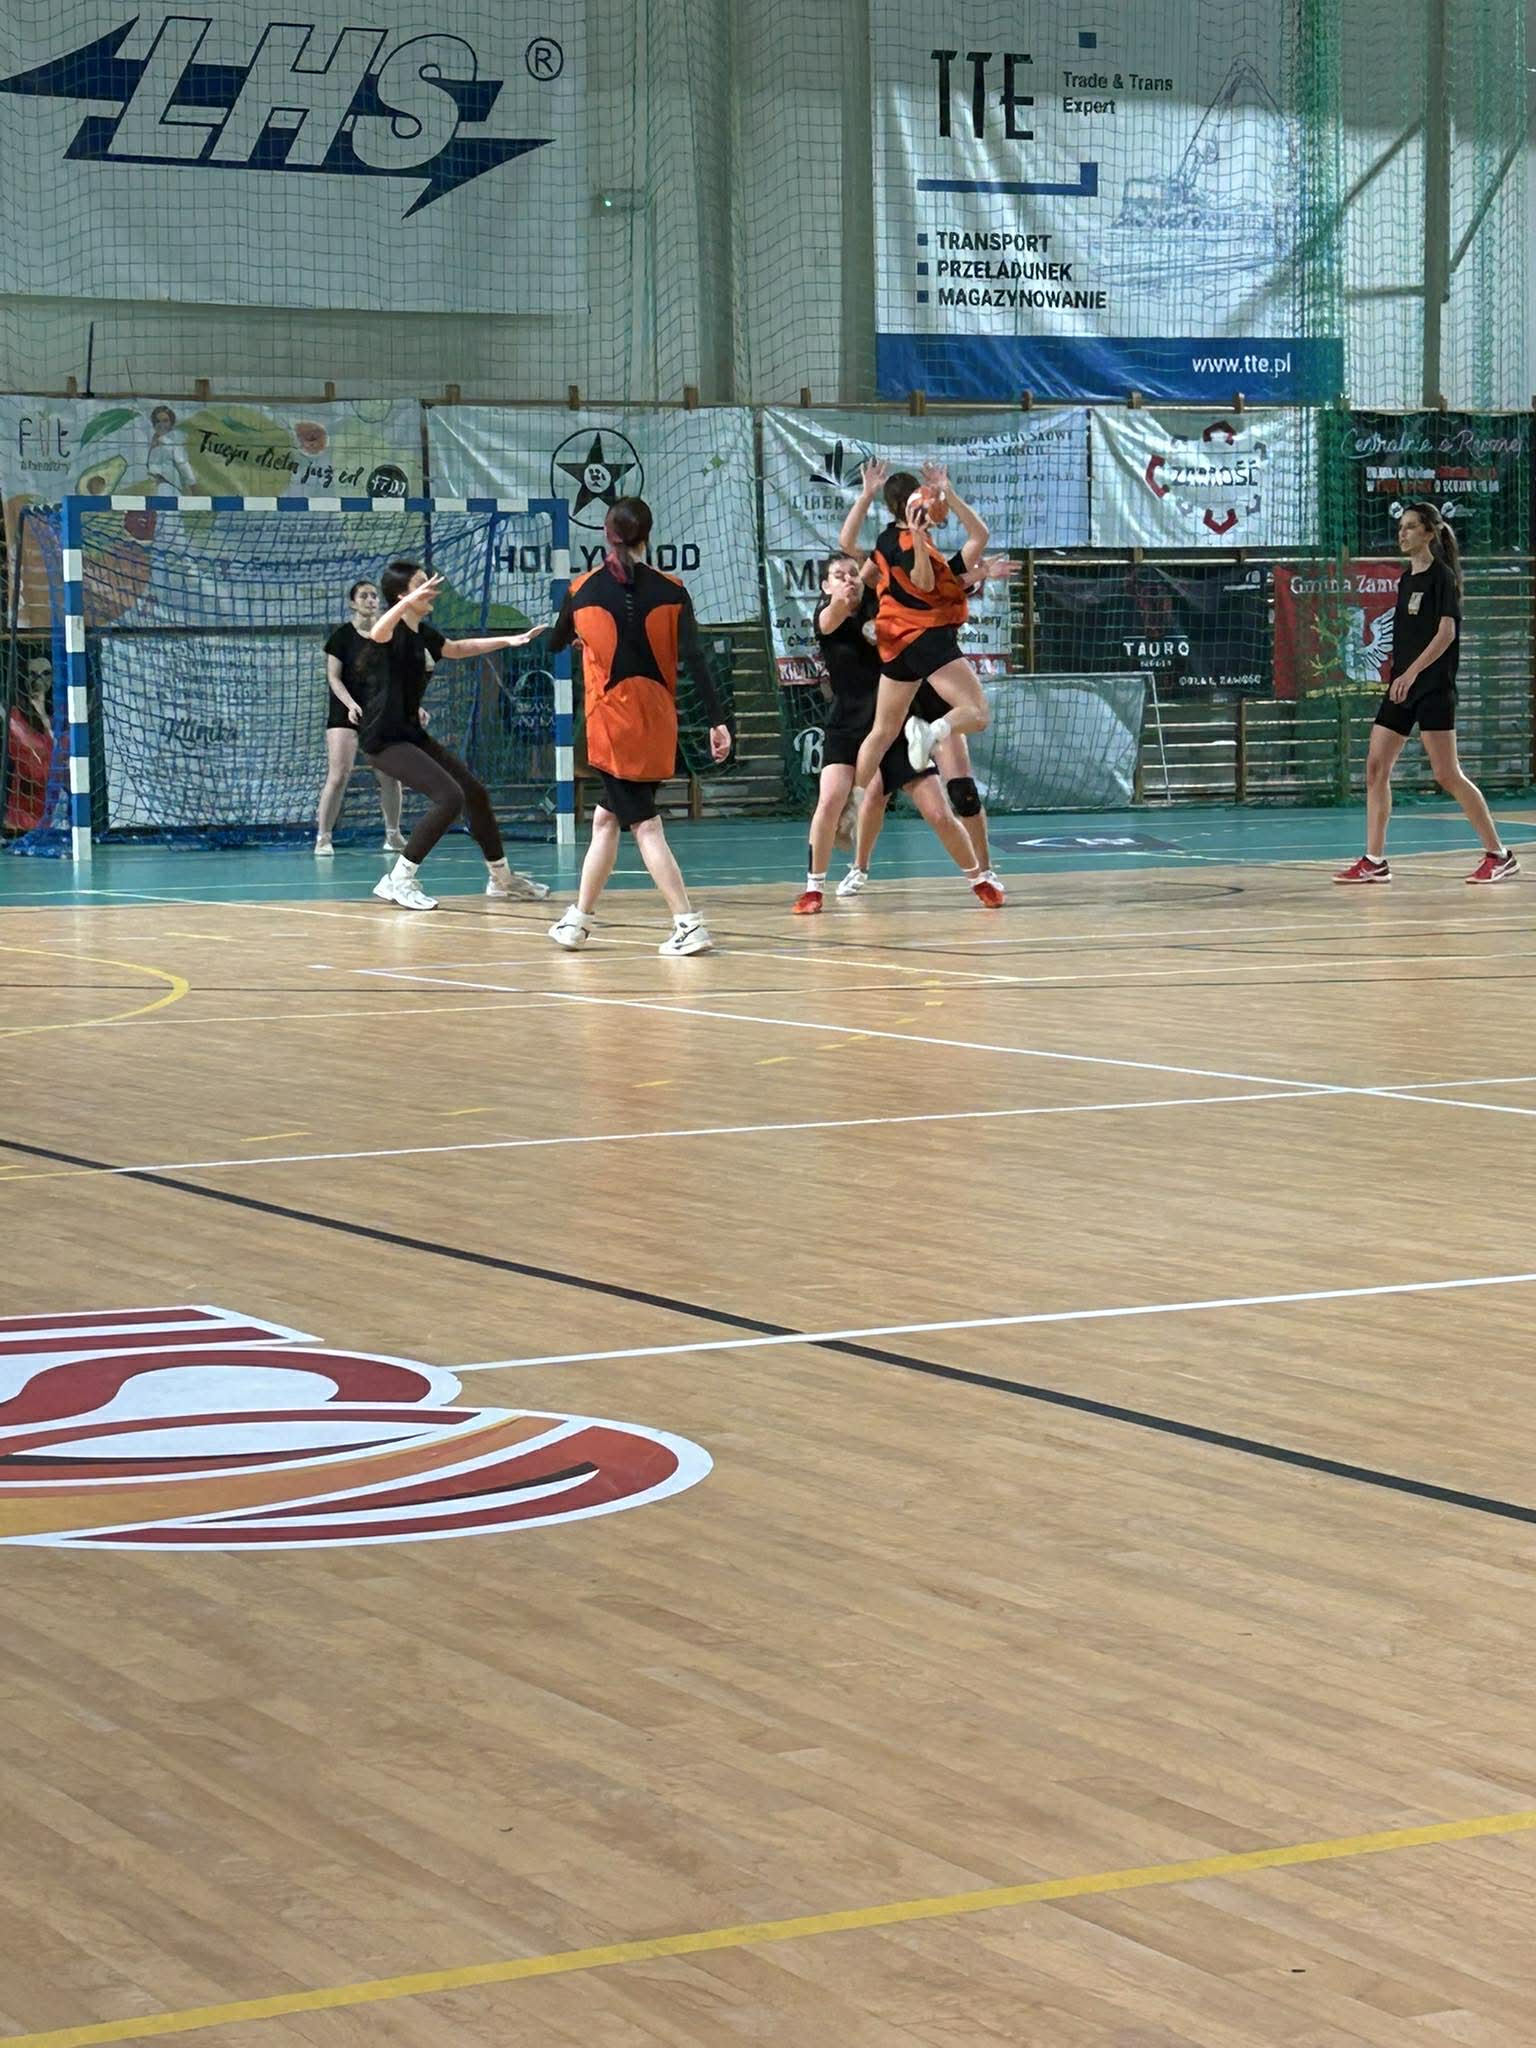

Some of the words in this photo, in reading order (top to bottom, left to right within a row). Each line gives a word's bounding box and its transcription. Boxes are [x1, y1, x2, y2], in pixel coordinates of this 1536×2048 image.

[1063, 70, 1108, 90] Trade
[1112, 73, 1124, 90] &
[1129, 73, 1173, 92] Trans
[930, 49, 1034, 140] TTE
[1062, 96, 1116, 117] Expert
[936, 231, 1052, 253] TRANSPORT
[938, 287, 1107, 309] MAGAZYNOWANIE
[1191, 352, 1292, 379] www.tte.pl
[1122, 641, 1190, 657] TAURO
